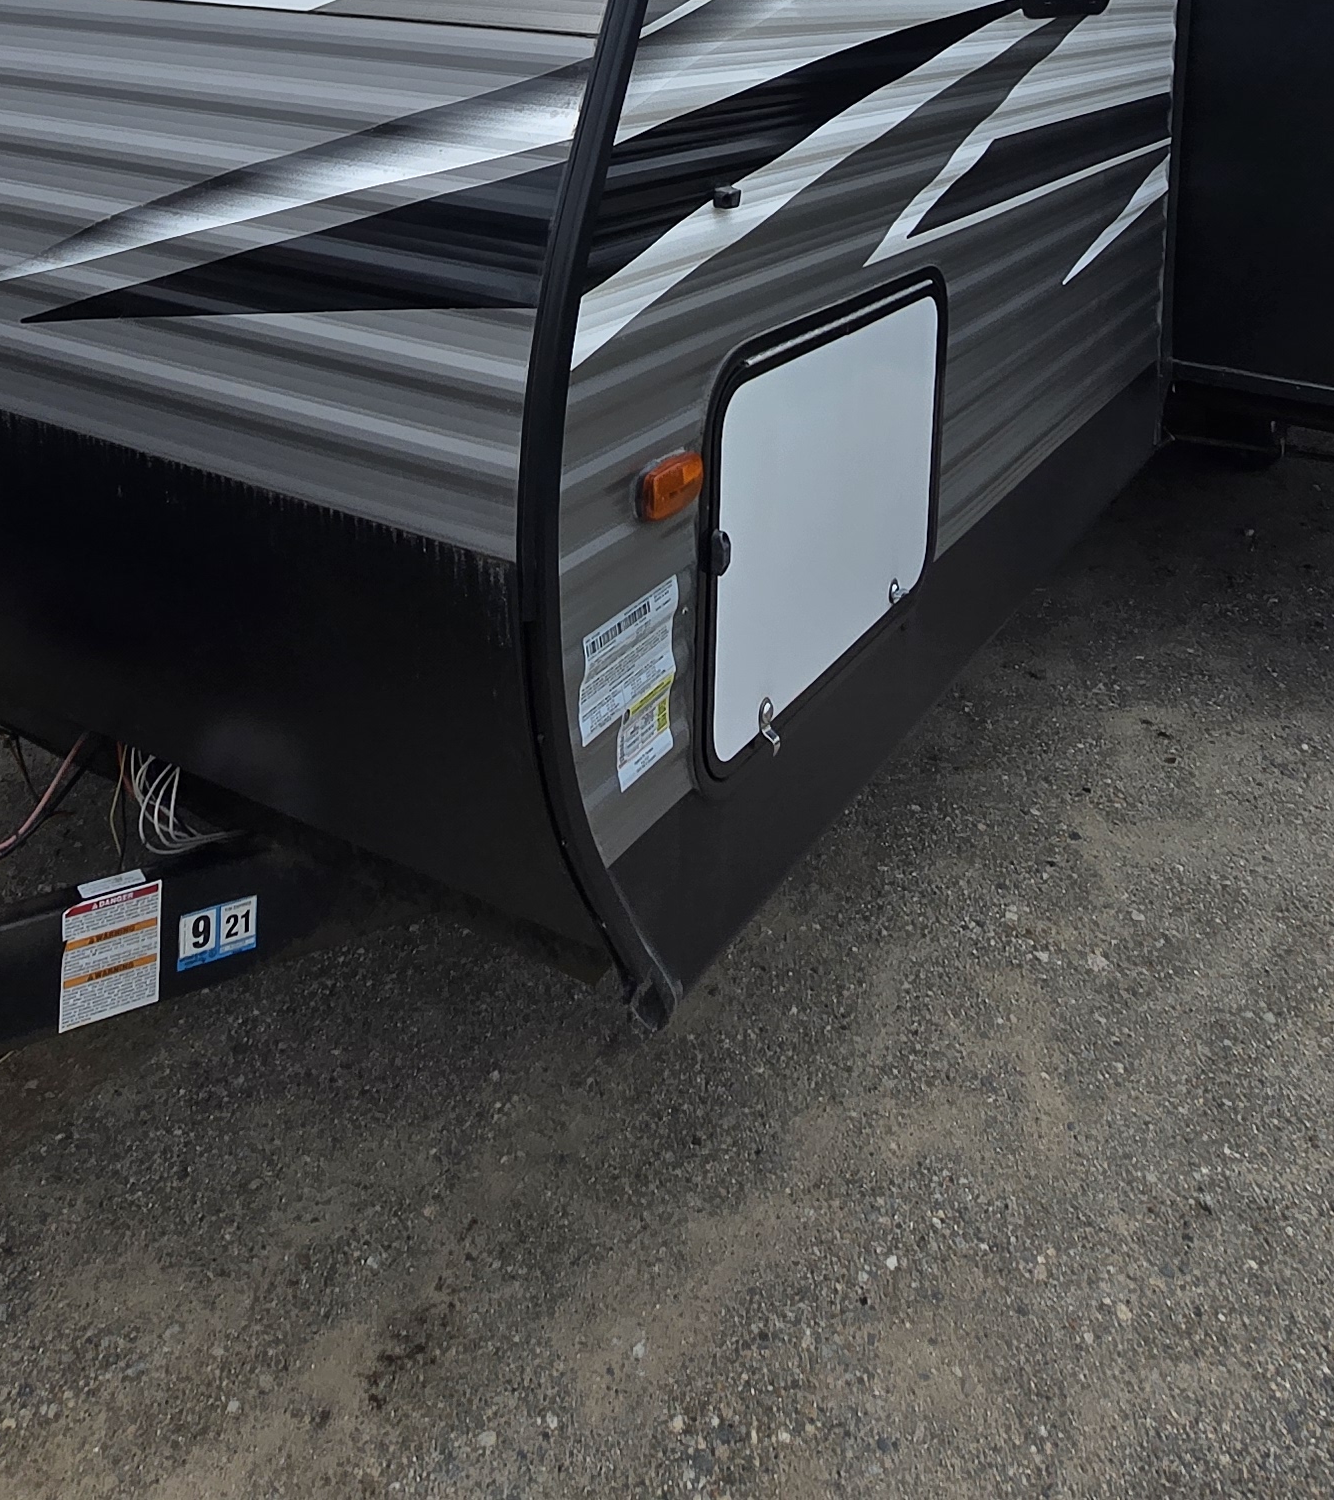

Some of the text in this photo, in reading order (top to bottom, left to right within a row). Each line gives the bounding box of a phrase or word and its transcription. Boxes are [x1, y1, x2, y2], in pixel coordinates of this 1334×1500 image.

[98, 891, 134, 909] DANGER
[192, 915, 211, 949] 9
[225, 909, 251, 939] 21
